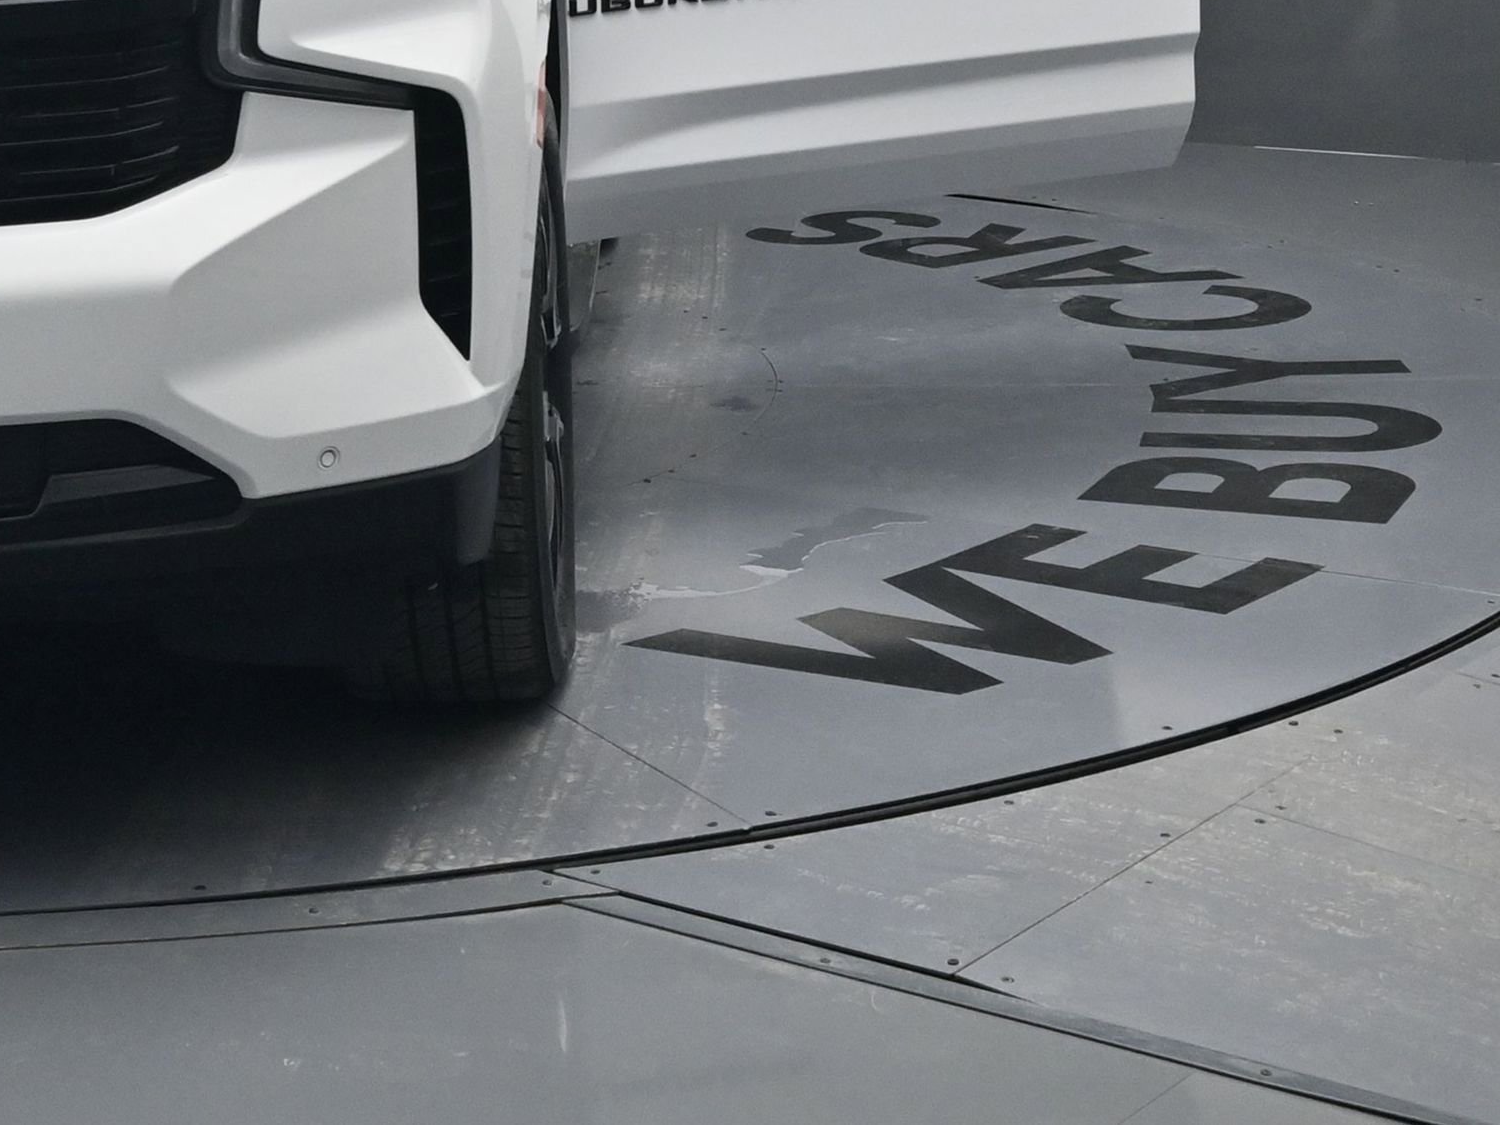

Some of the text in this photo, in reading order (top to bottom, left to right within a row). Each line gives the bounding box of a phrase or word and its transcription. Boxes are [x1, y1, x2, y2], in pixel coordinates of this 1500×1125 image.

[622, 210, 1443, 694] WE BUY CARS
